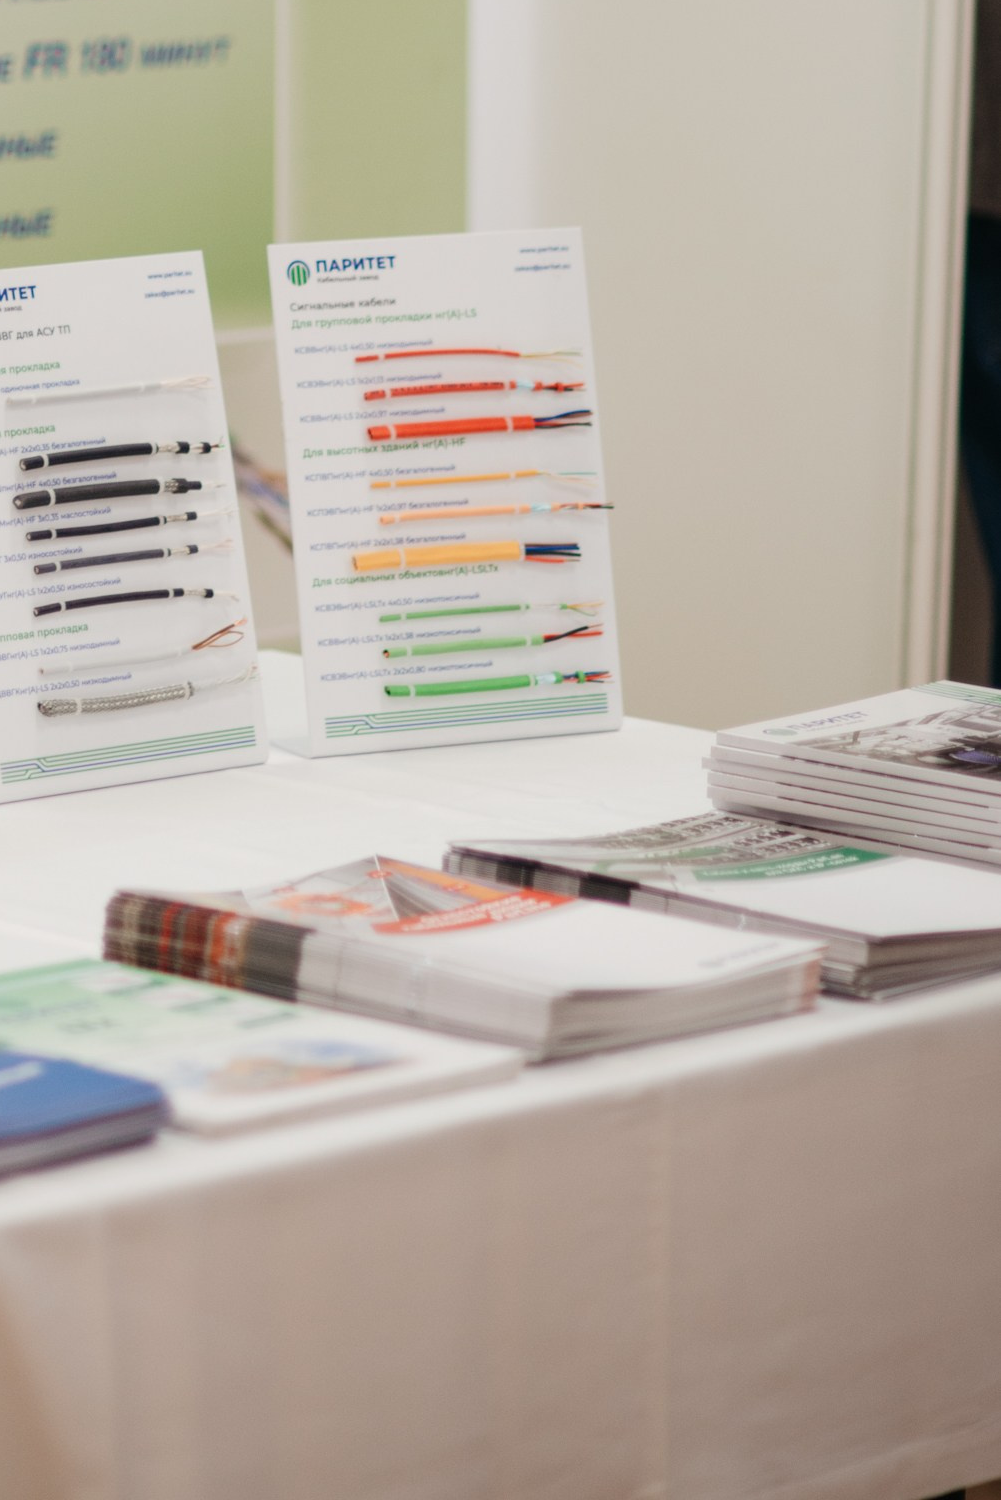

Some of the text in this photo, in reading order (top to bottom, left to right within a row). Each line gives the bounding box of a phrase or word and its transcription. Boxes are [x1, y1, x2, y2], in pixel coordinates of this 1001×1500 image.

[23, 41, 70, 79] FR
[80, 36, 131, 75] 180
[316, 255, 396, 273] ПАРИТЕТ
[3, 306, 22, 314] завод
[290, 296, 396, 312] Сигнальные кабели
[15, 329, 34, 341] для
[36, 325, 54, 337] АСУ
[57, 323, 71, 335] ТП
[8, 361, 61, 377] прокладка
[3, 424, 56, 440] прокладка
[36, 624, 89, 641] прокладка
